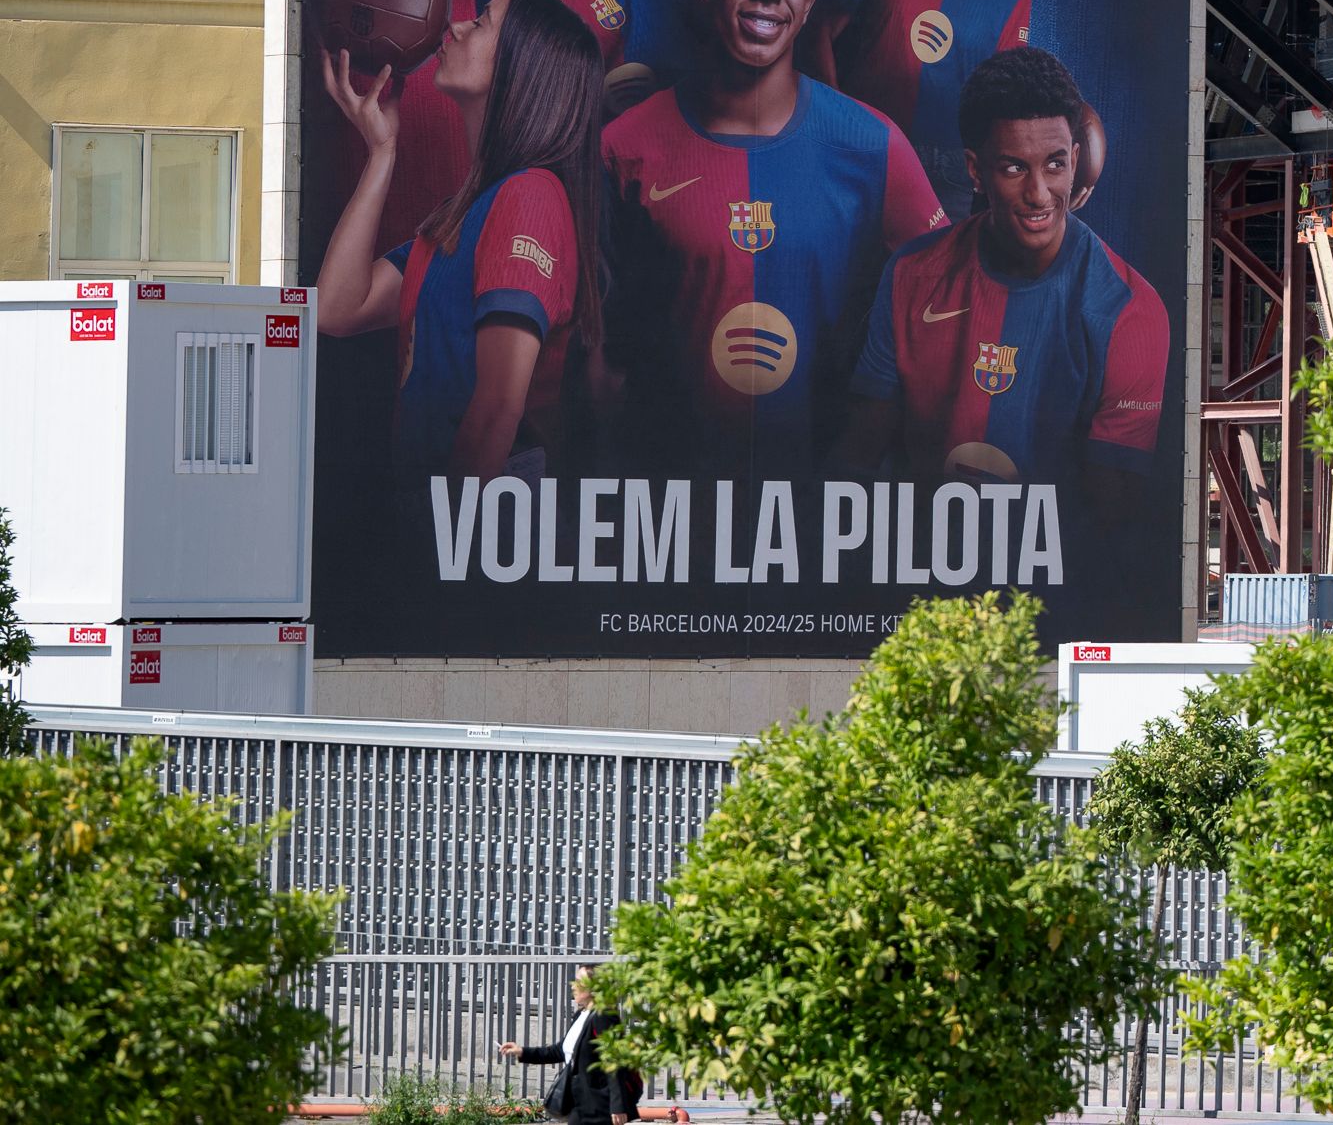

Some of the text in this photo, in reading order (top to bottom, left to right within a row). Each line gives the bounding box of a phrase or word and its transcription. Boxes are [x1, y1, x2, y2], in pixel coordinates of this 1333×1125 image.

[430, 475, 1064, 586] VOLEM LA PILOTA
[600, 614, 622, 633] FC
[628, 614, 738, 633] BARCELONA
[743, 615, 815, 633] 2024/25
[821, 615, 875, 633] HOME
